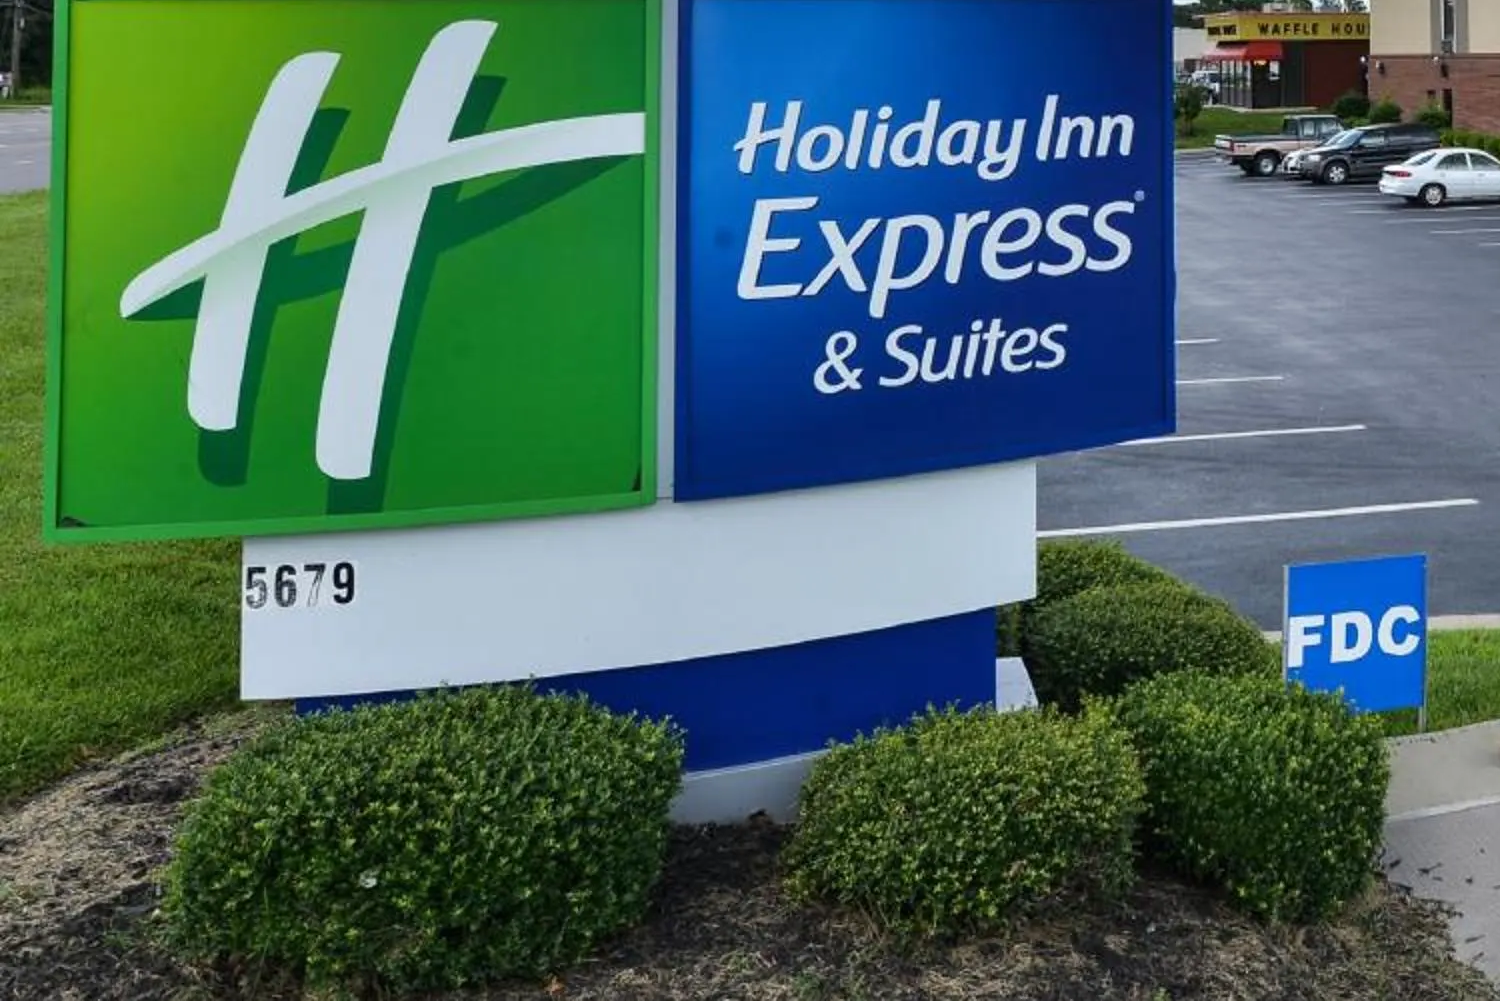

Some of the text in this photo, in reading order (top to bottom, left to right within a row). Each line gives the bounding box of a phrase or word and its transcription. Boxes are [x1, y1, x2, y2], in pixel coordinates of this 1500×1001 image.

[1258, 22, 1370, 36] WAFFLE HOU
[733, 94, 1134, 182] Holiday Inn
[737, 196, 1135, 318] Express
[813, 318, 1068, 394] & Suites
[245, 562, 355, 609] 5679
[1287, 605, 1421, 668] FDC
